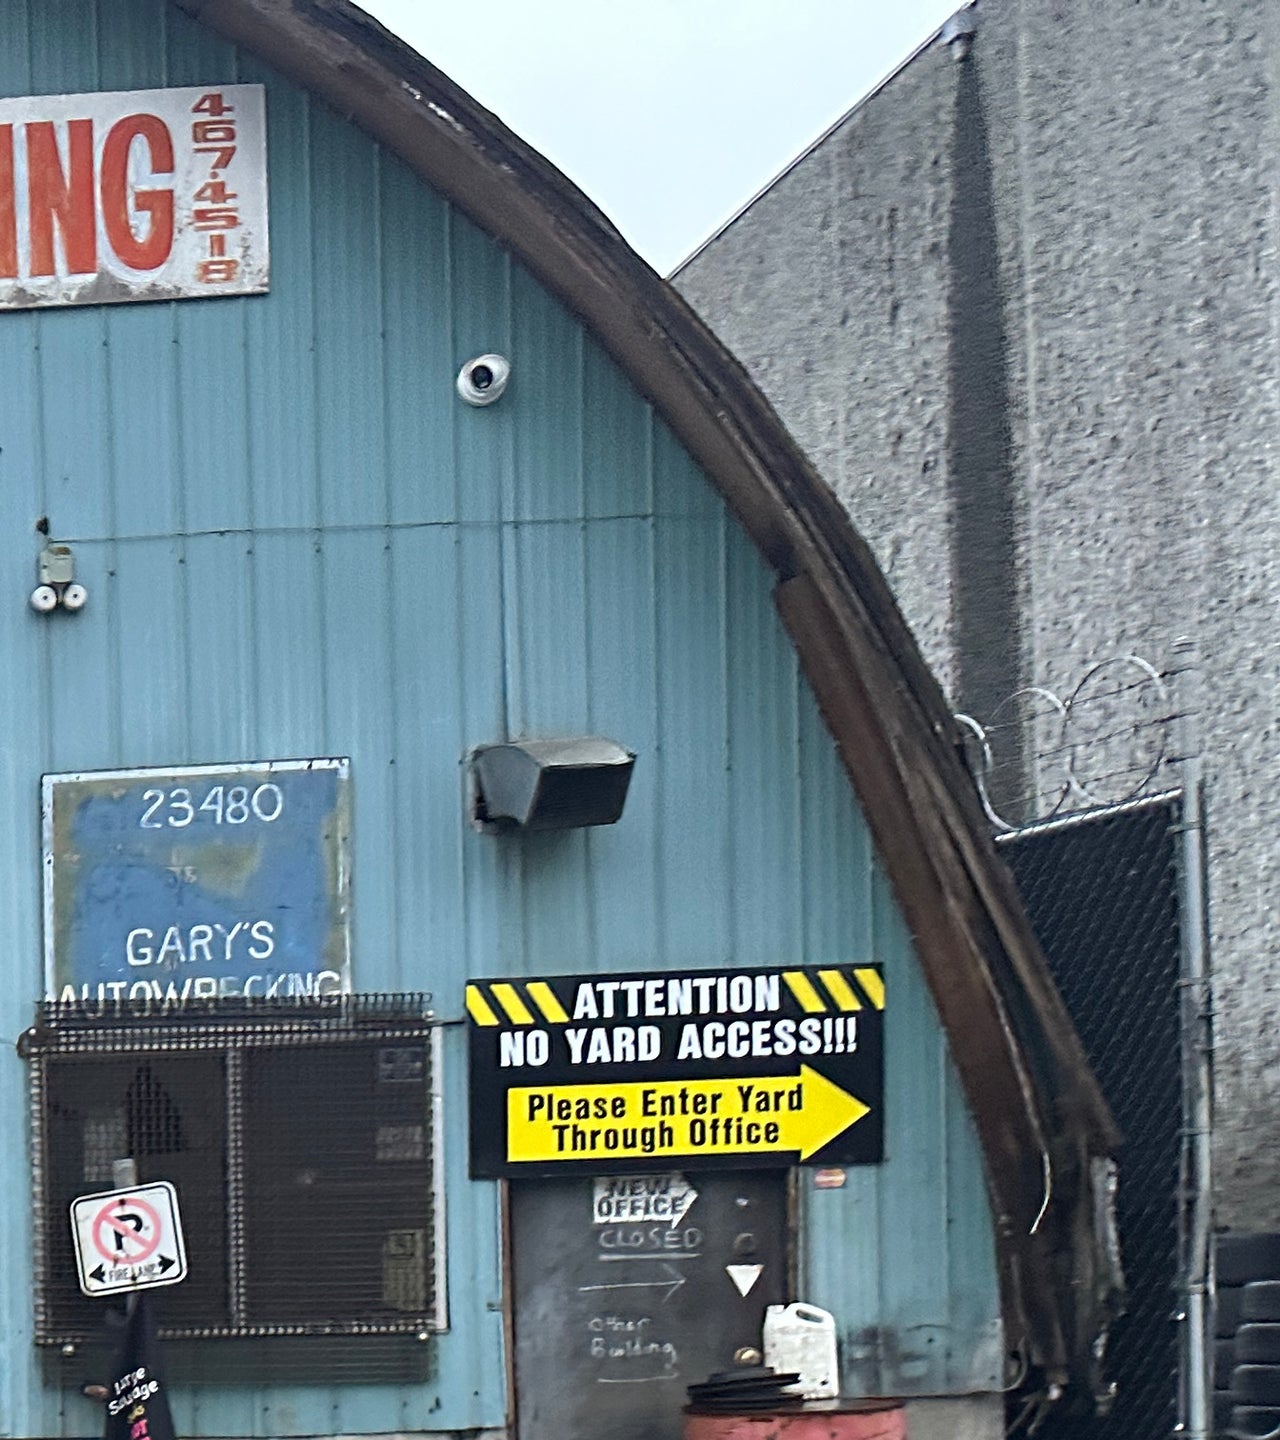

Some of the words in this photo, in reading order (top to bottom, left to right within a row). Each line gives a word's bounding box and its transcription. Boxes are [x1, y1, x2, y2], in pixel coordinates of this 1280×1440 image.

[140, 782, 285, 829] 23480
[126, 920, 275, 967] GARY'S
[572, 975, 781, 1021] ATTENTION
[500, 1029, 550, 1068] NO
[565, 1025, 662, 1065] YARD
[676, 1016, 858, 1061] ACCESS!!!
[527, 1092, 626, 1122] Please
[641, 1088, 723, 1117] Enter
[736, 1082, 804, 1113] Yard
[552, 1121, 674, 1153] Through
[689, 1116, 780, 1147] Office
[597, 1194, 687, 1218] OFFICE
[598, 1226, 703, 1250] CLOSED
